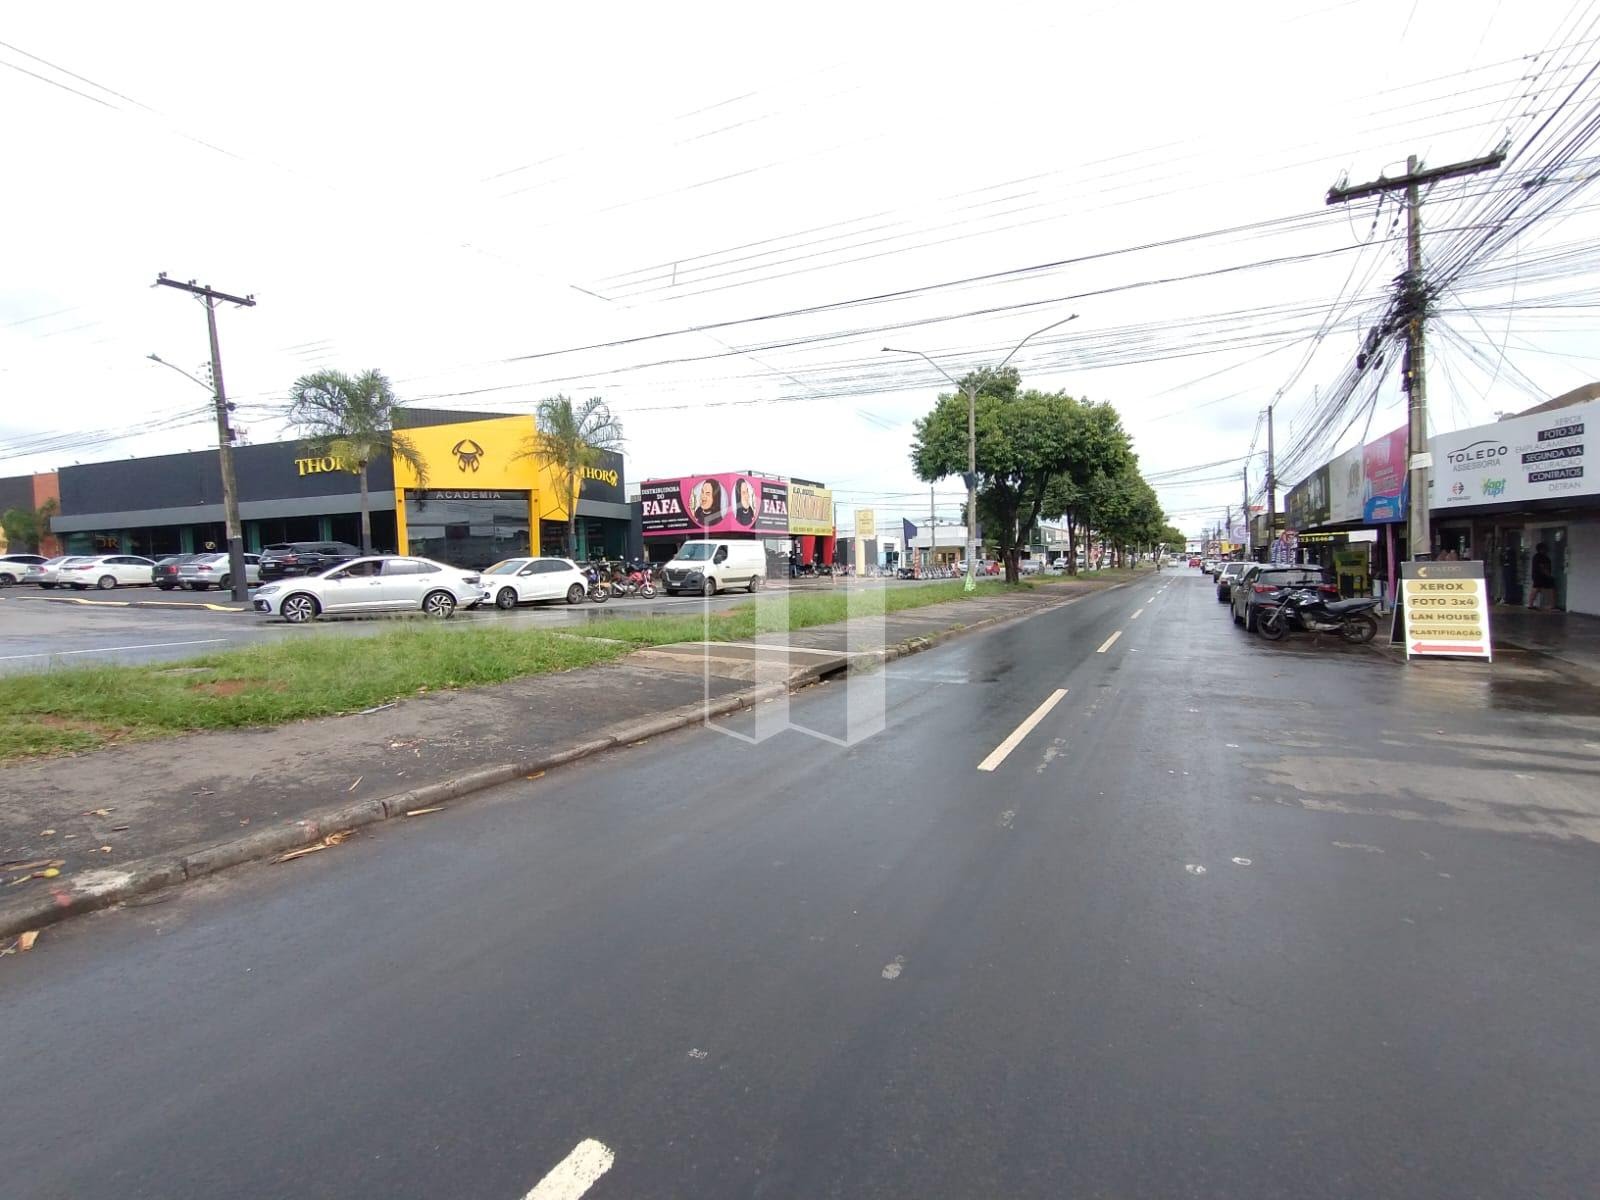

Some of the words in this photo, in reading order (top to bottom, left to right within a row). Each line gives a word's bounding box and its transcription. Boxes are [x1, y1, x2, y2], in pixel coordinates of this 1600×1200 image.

[1543, 428, 1567, 440] FOTO
[1567, 425, 1583, 435] 3/4
[1447, 445, 1508, 464] TOLEDO
[1525, 449, 1565, 462] SEGUNDA
[1567, 446, 1582, 456] VIA
[1453, 458, 1501, 472] ASSESSORIA
[1530, 468, 1582, 481] CONTRATOS
[436, 491, 501, 499] ACADEMIA
[642, 498, 681, 516] FAFA
[763, 498, 787, 514] FAFA
[1420, 583, 1464, 591] XEROX
[1411, 598, 1447, 606] FOTO
[1451, 598, 1474, 606] 3x4
[1411, 613, 1433, 621] LAN
[1437, 613, 1479, 621] HOUSE
